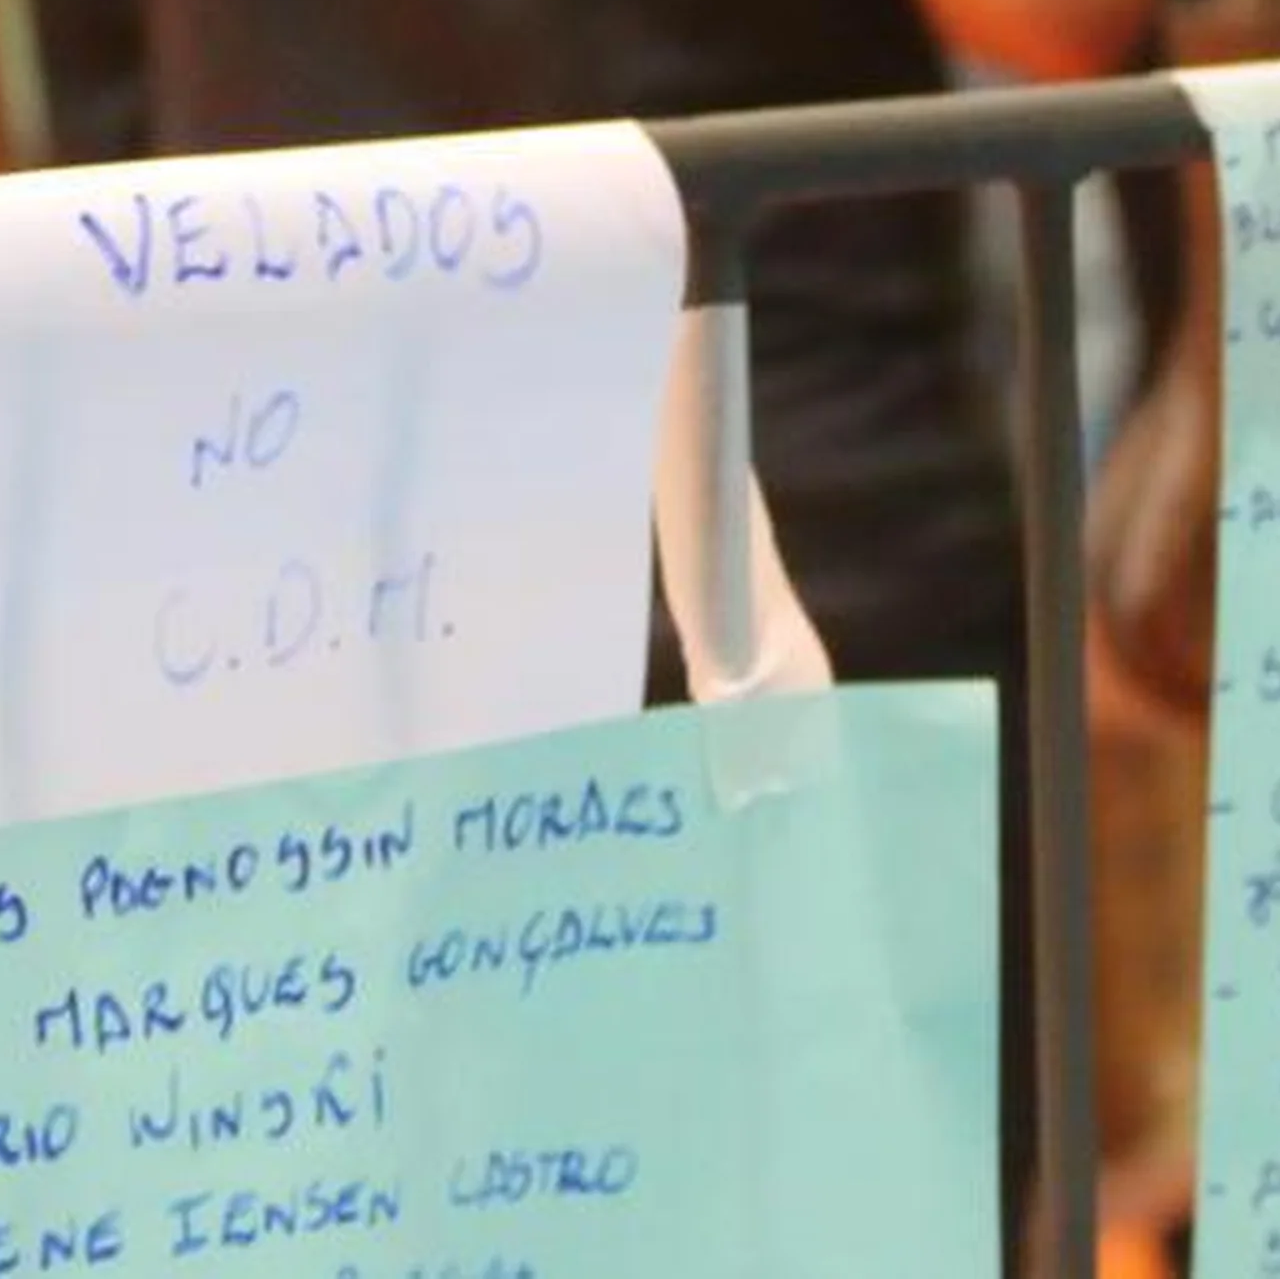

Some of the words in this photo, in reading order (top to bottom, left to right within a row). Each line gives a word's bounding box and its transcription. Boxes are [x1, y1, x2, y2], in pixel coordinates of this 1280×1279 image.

[80, 184, 543, 296] VELADOS
[188, 388, 303, 489] NO
[453, 776, 685, 852] MORAES
[35, 951, 356, 1053] MARQUES
[408, 901, 718, 1000] GONÇALVES
